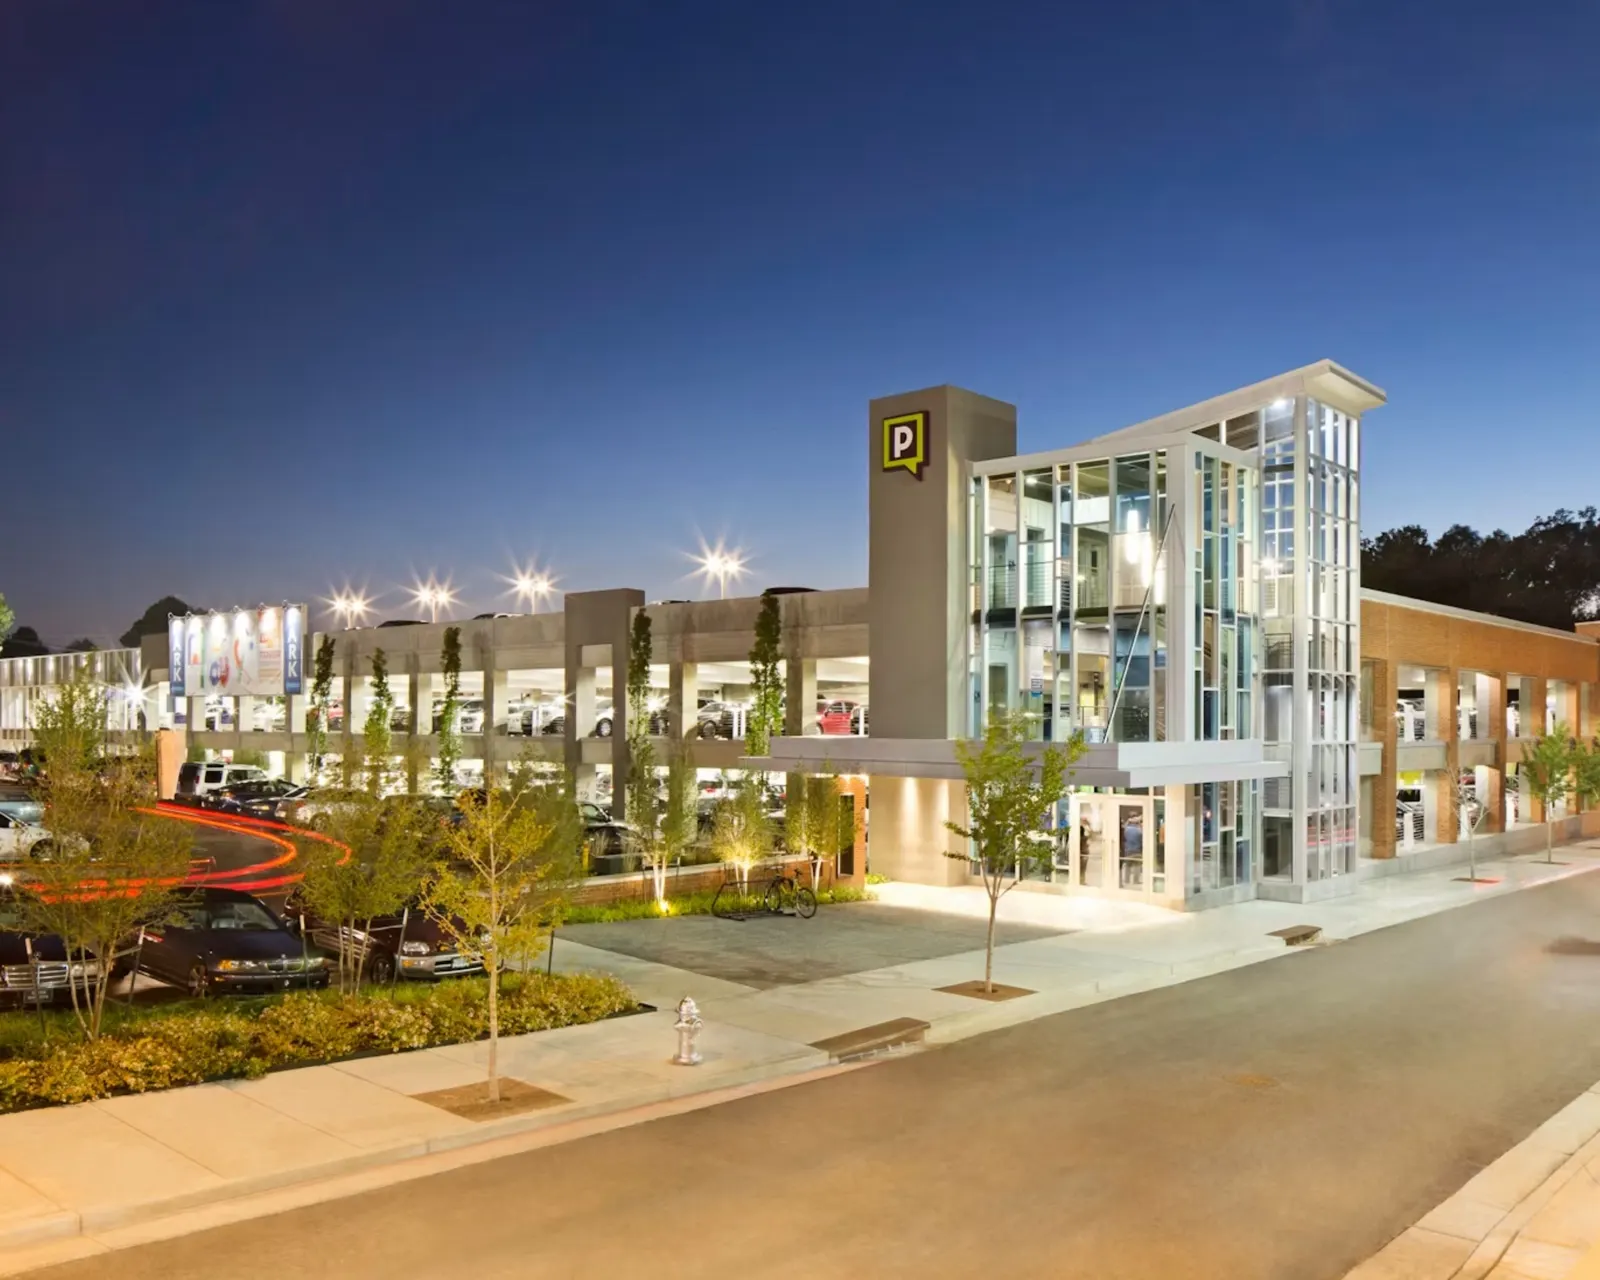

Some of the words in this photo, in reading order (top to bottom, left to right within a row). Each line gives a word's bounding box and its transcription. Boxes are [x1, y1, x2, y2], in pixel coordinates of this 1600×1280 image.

[894, 425, 913, 458] P
[173, 625, 182, 682] ARK
[288, 613, 298, 677] ARK
